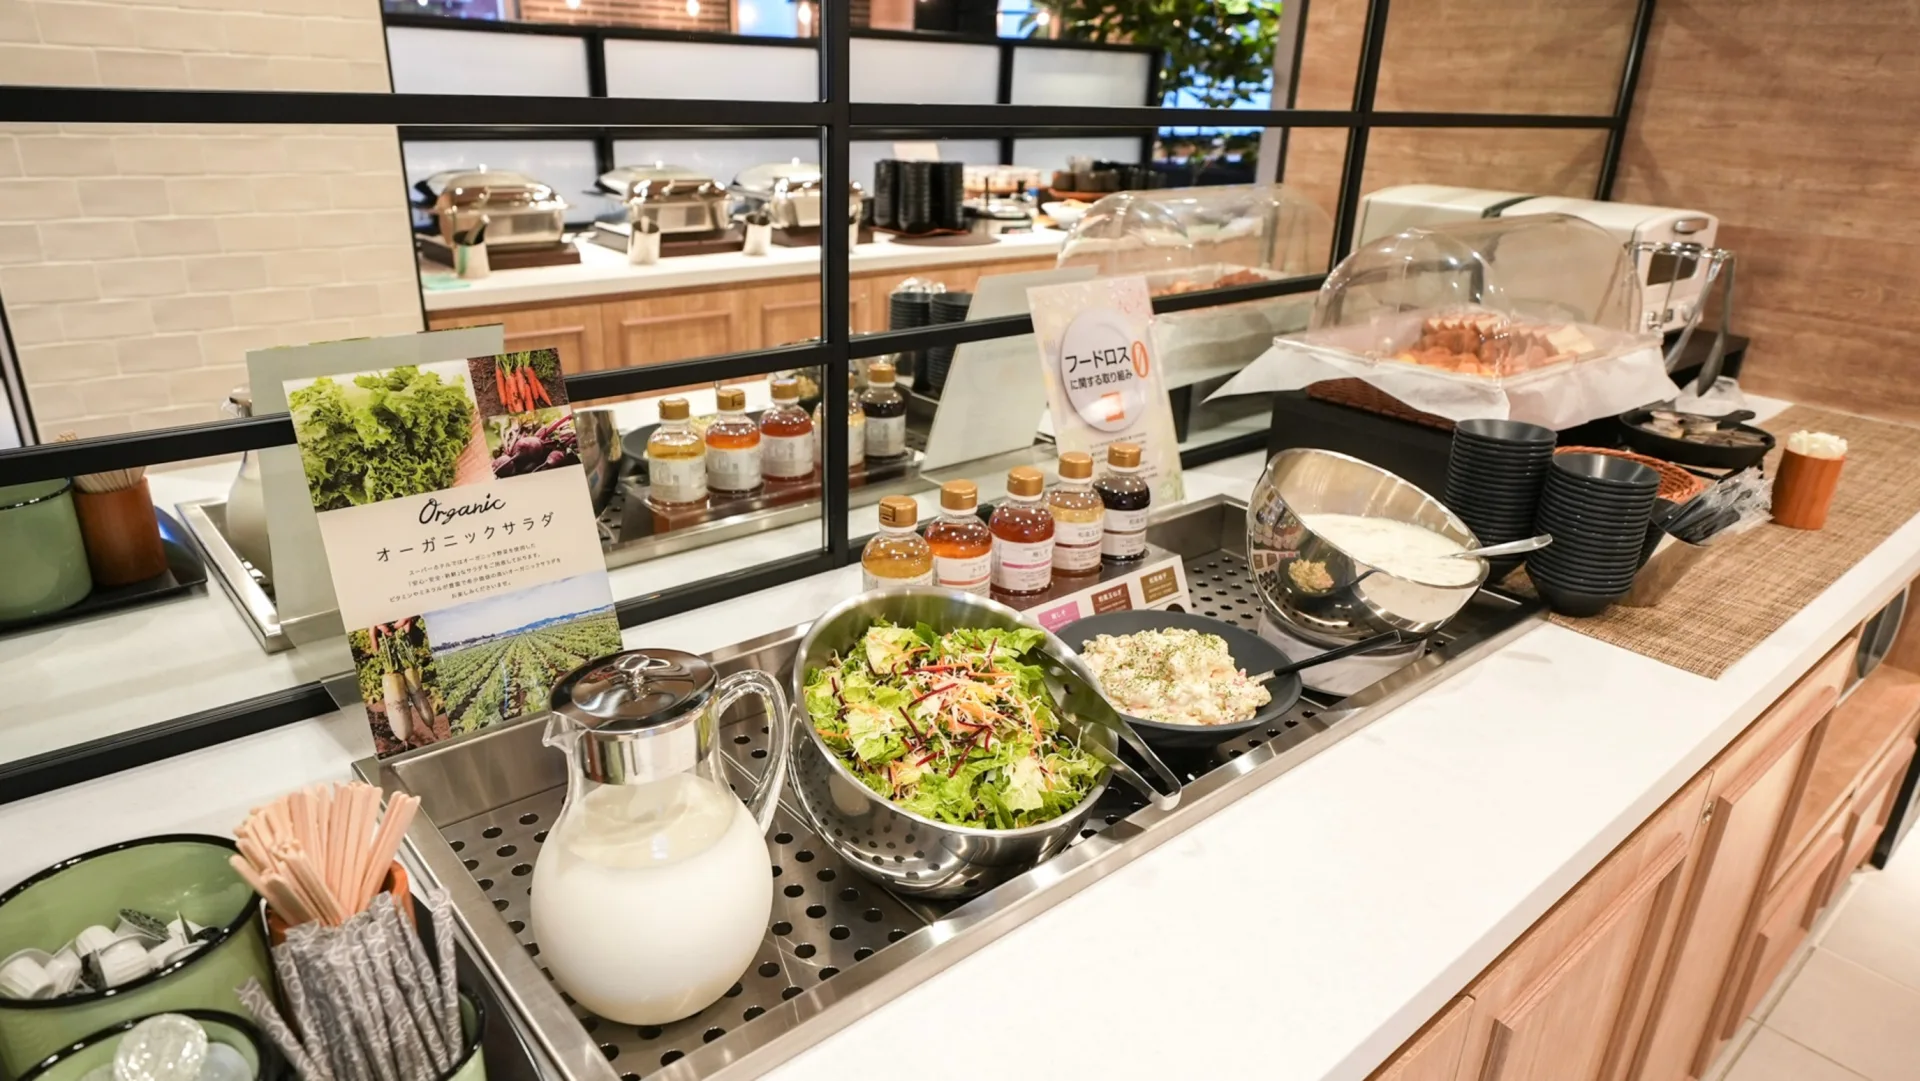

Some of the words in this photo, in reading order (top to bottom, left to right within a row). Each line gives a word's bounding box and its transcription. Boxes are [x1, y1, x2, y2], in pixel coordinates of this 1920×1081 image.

[1070, 369, 1134, 391] に関する取り組み
[418, 492, 507, 525] Organic
[376, 511, 555, 563] オーガニックサラダ
